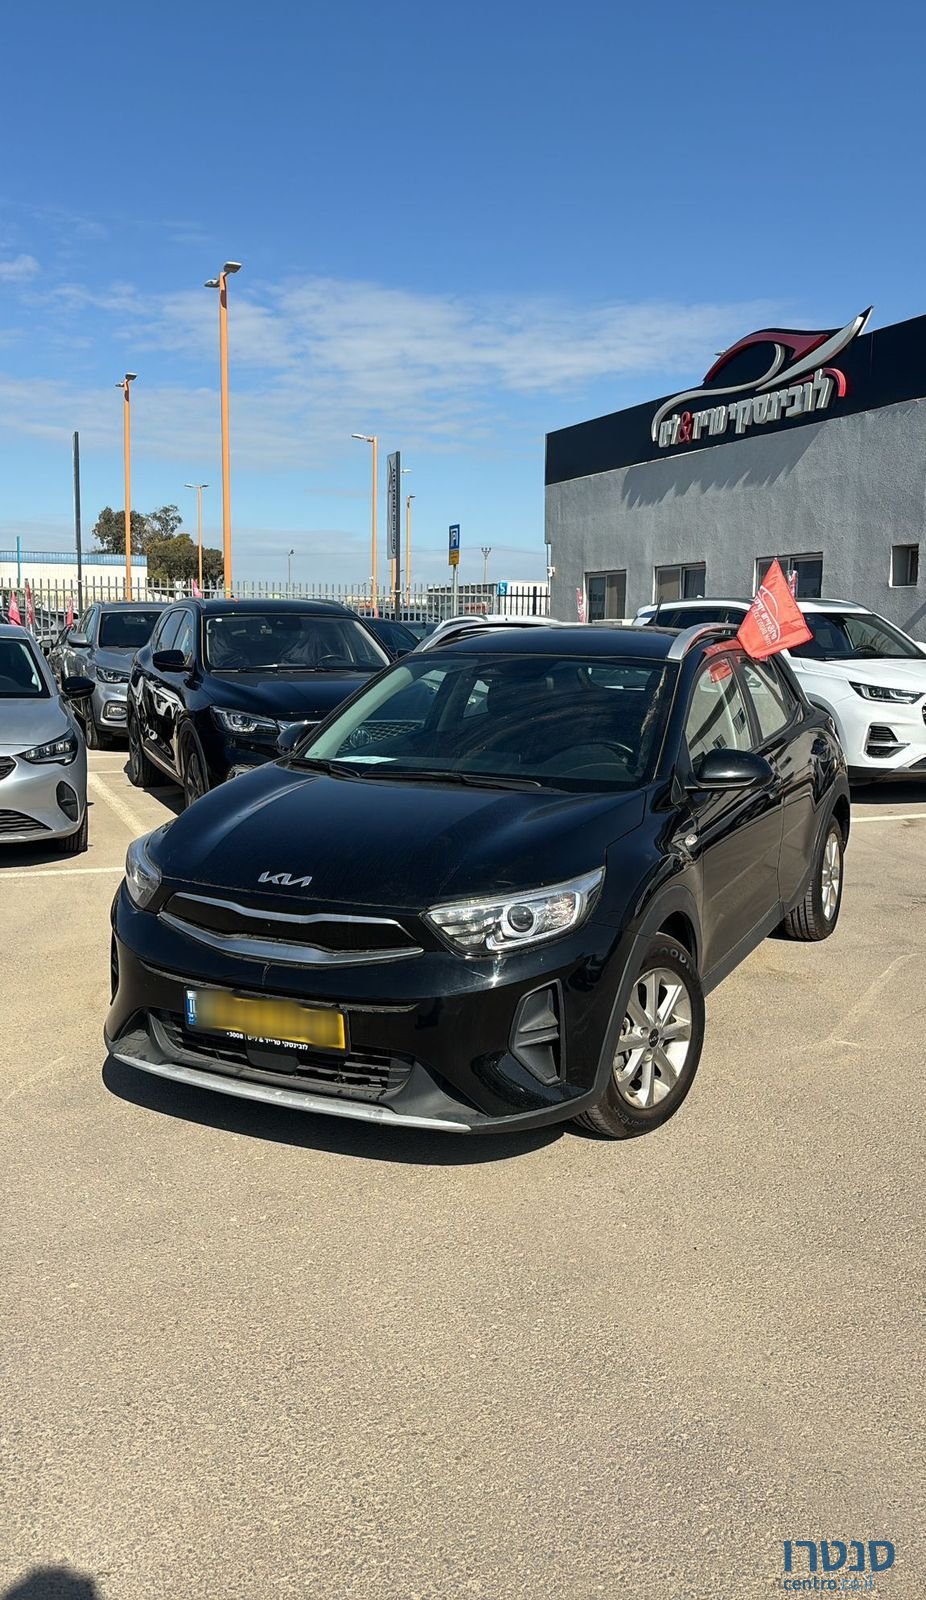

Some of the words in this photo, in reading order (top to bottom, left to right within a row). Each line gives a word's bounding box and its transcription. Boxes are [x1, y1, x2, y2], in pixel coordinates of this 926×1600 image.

[728, 368, 835, 434] לובינסקי
[258, 871, 313, 887] KIA
[282, 1041, 308, 1050] לובינסקי
